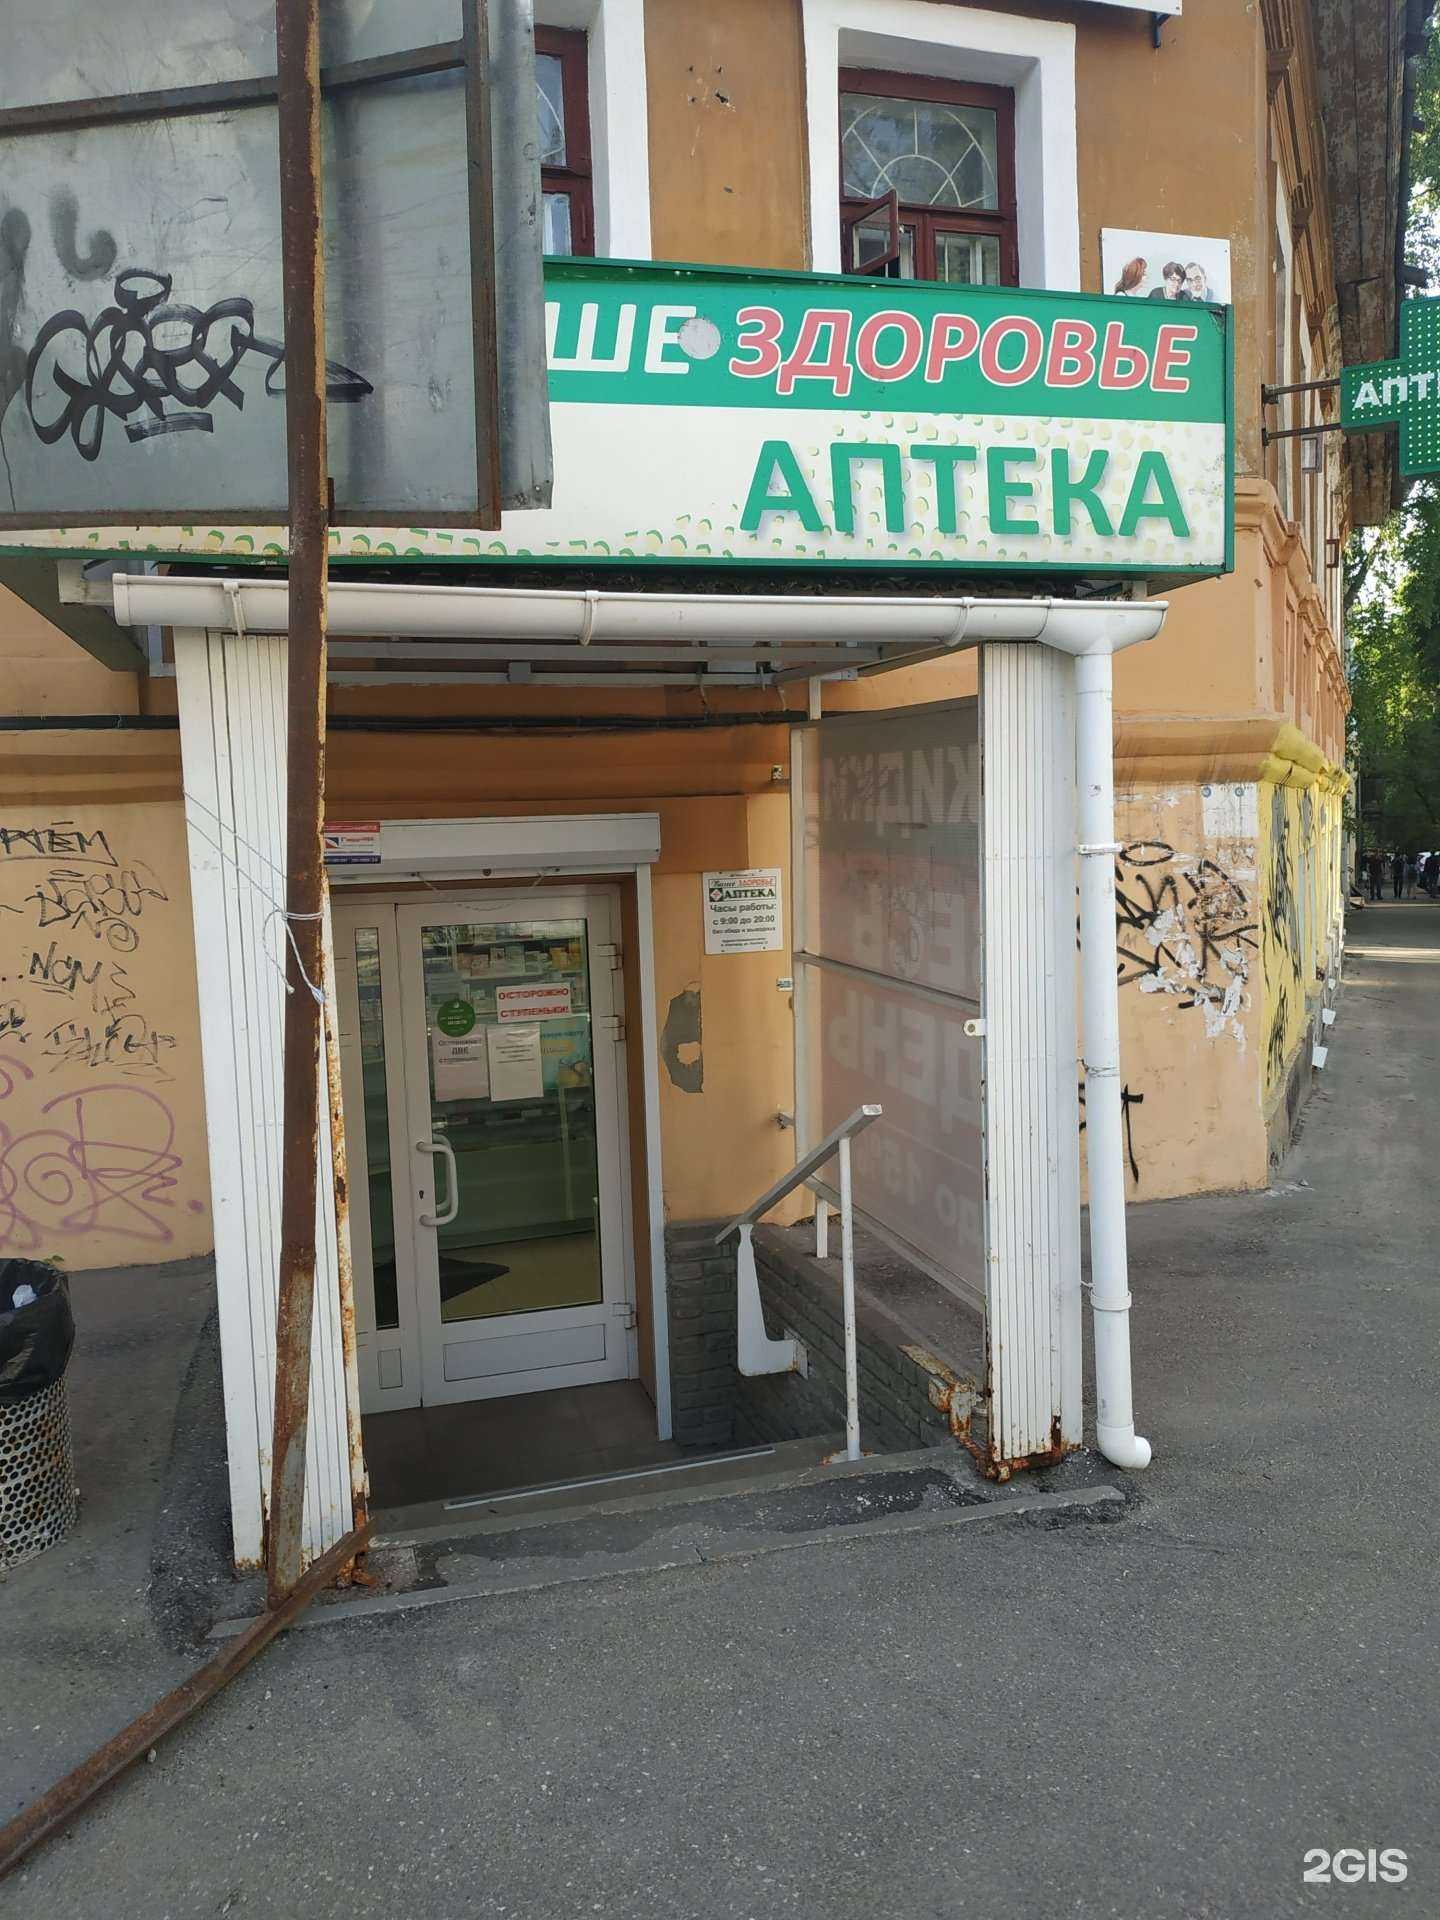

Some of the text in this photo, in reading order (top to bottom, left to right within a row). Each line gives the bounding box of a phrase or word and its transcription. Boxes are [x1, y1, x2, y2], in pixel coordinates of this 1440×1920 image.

[544, 301, 1199, 397] ШЕ ЗДОРОВЬЕ
[1353, 371, 1440, 410] АПТ
[739, 439, 1191, 538] АПТЕКА
[723, 888, 775, 899] АПТЕКА
[710, 902, 777, 914] Часы работы:
[712, 918, 719, 926] с
[739, 917, 752, 925] до
[498, 987, 569, 1000] ОСТОРОЖНО
[500, 1005, 569, 1019] СТУПЕНЬКИ!
